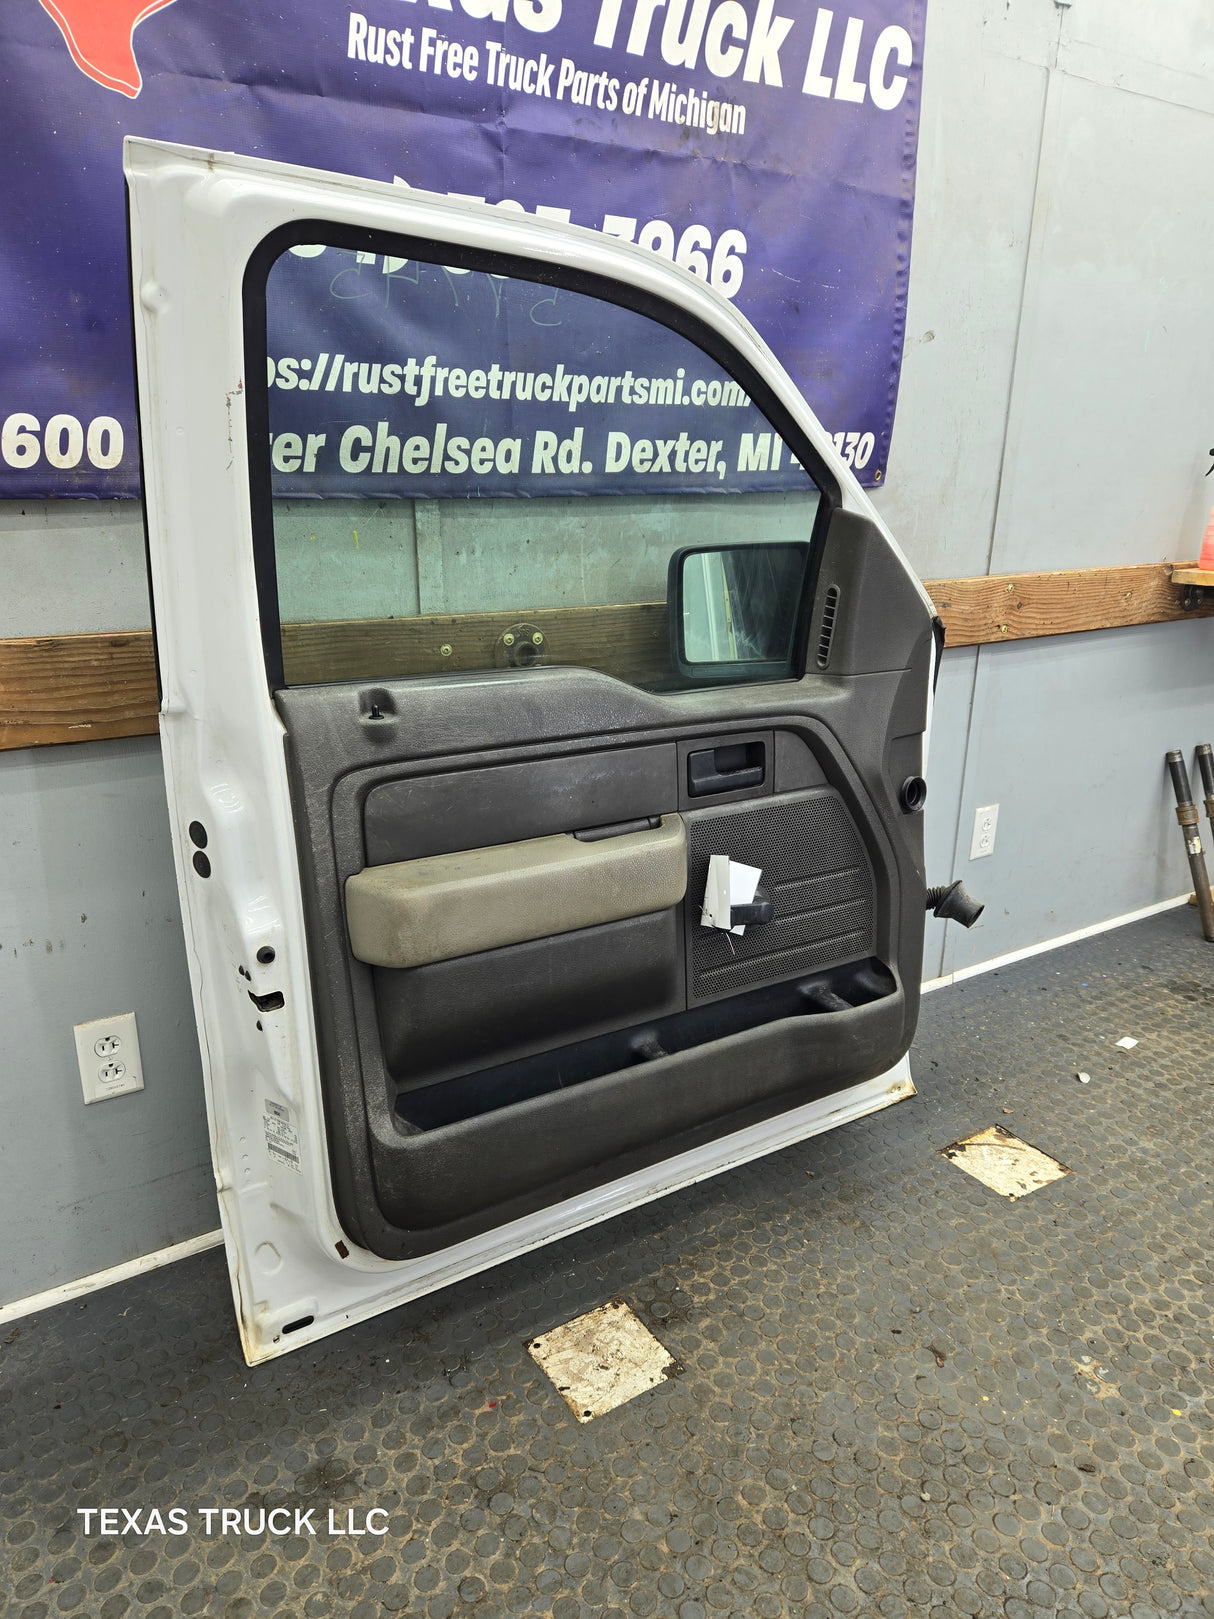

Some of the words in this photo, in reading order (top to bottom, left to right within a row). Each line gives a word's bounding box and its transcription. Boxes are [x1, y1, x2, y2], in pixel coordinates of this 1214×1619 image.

[347, 12, 415, 70] Rust
[419, 27, 480, 81] Free
[485, 41, 555, 98] Truck
[556, 57, 620, 111] Parts
[622, 77, 650, 117] of
[648, 79, 747, 135] Michigan
[802, 7, 913, 111] LLC
[1, 412, 125, 469] 600
[269, 432, 327, 473] er
[339, 421, 522, 474] Chelsea
[531, 427, 593, 474] Rd.
[605, 432, 727, 480] Dexter,
[737, 432, 783, 471] MI
